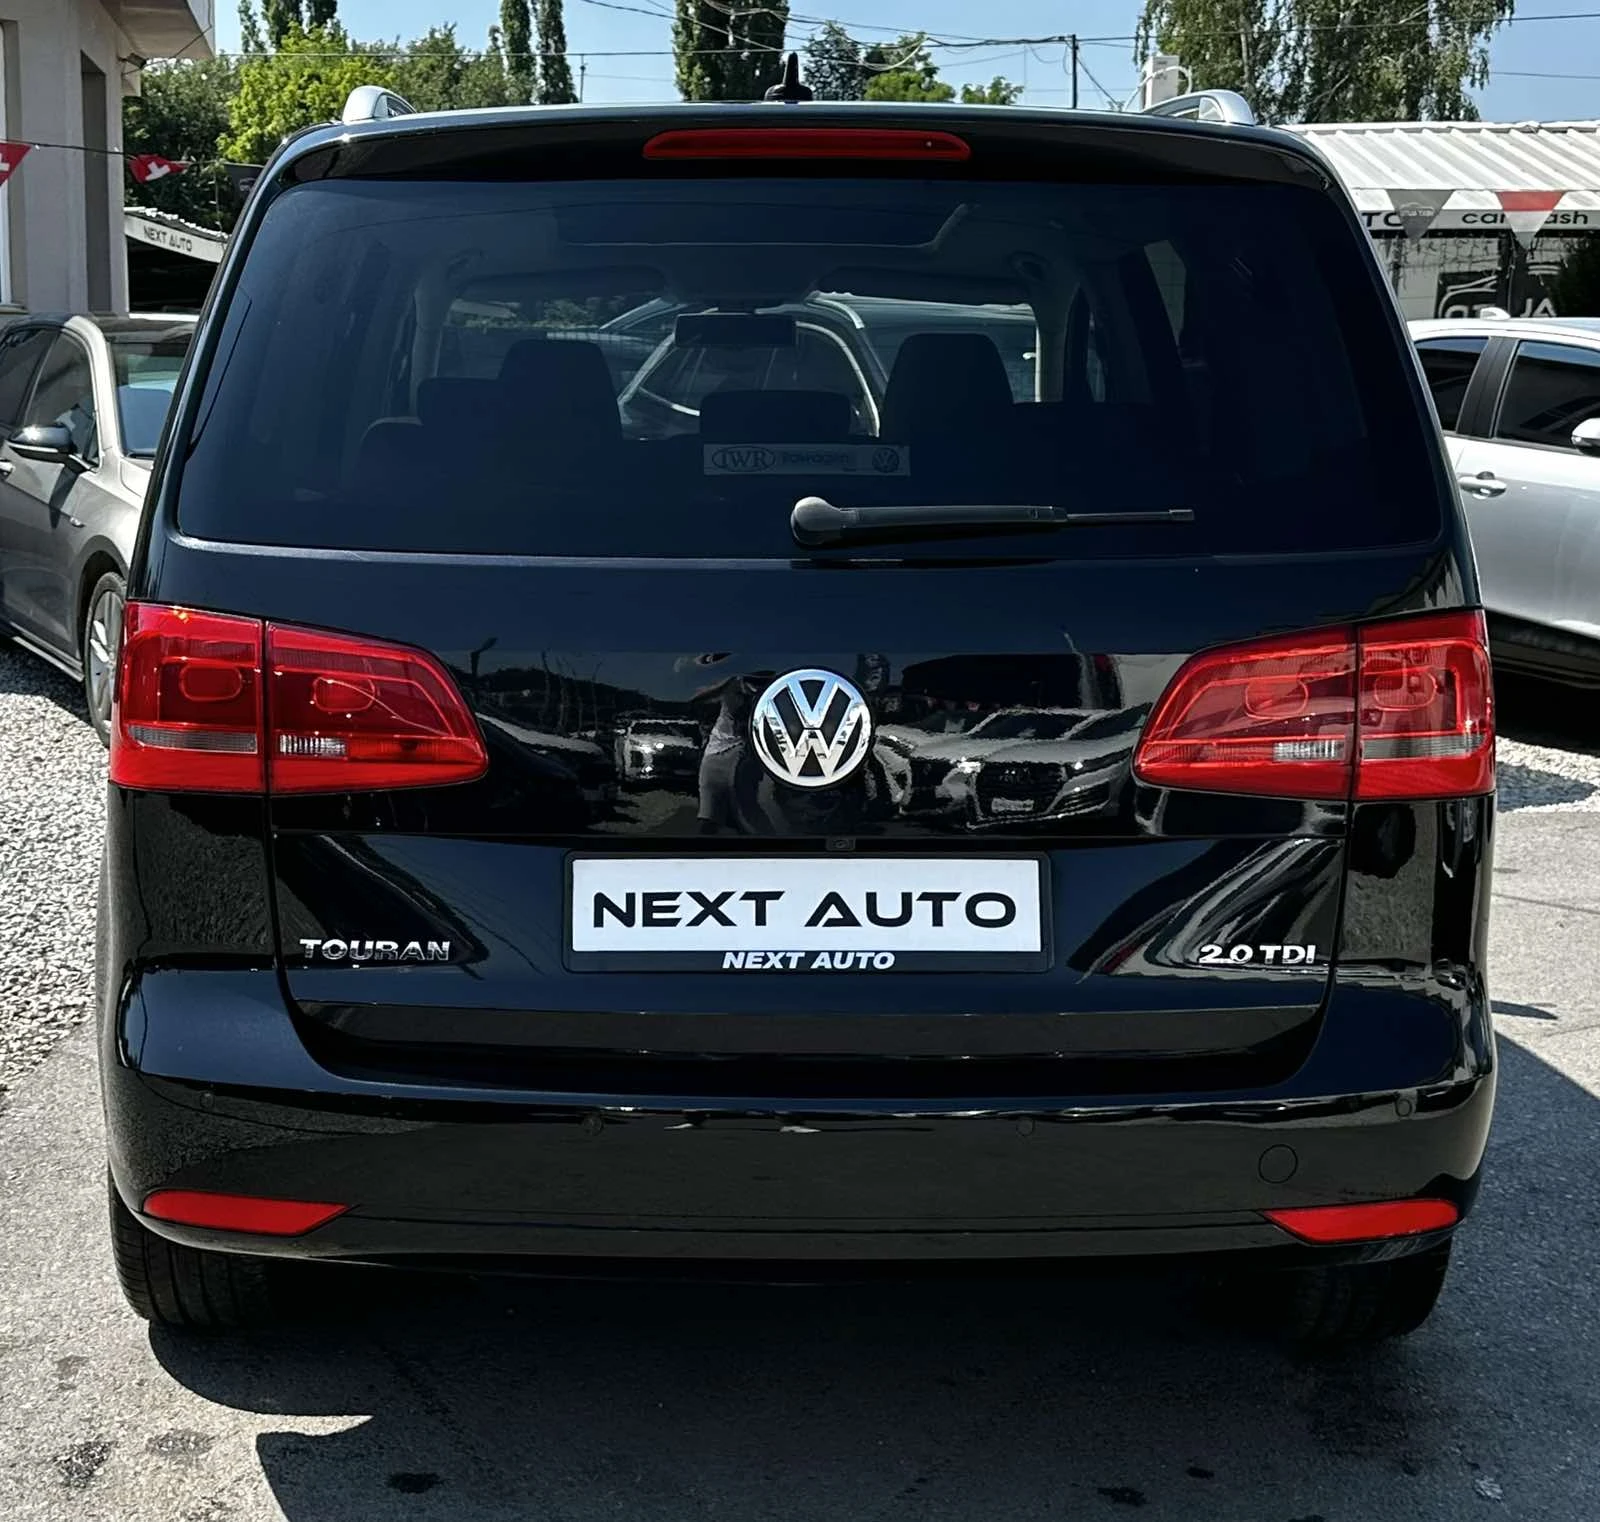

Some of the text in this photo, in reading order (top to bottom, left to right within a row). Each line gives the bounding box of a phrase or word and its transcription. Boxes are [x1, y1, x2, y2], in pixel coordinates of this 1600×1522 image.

[1545, 211, 1588, 225] ash
[144, 226, 167, 243] NEXT
[593, 890, 1017, 928] NEXT AUTO
[299, 938, 450, 961] TOURAN
[1199, 943, 1317, 965] 2.0 TDI
[722, 951, 896, 970] NEXT AUTO
